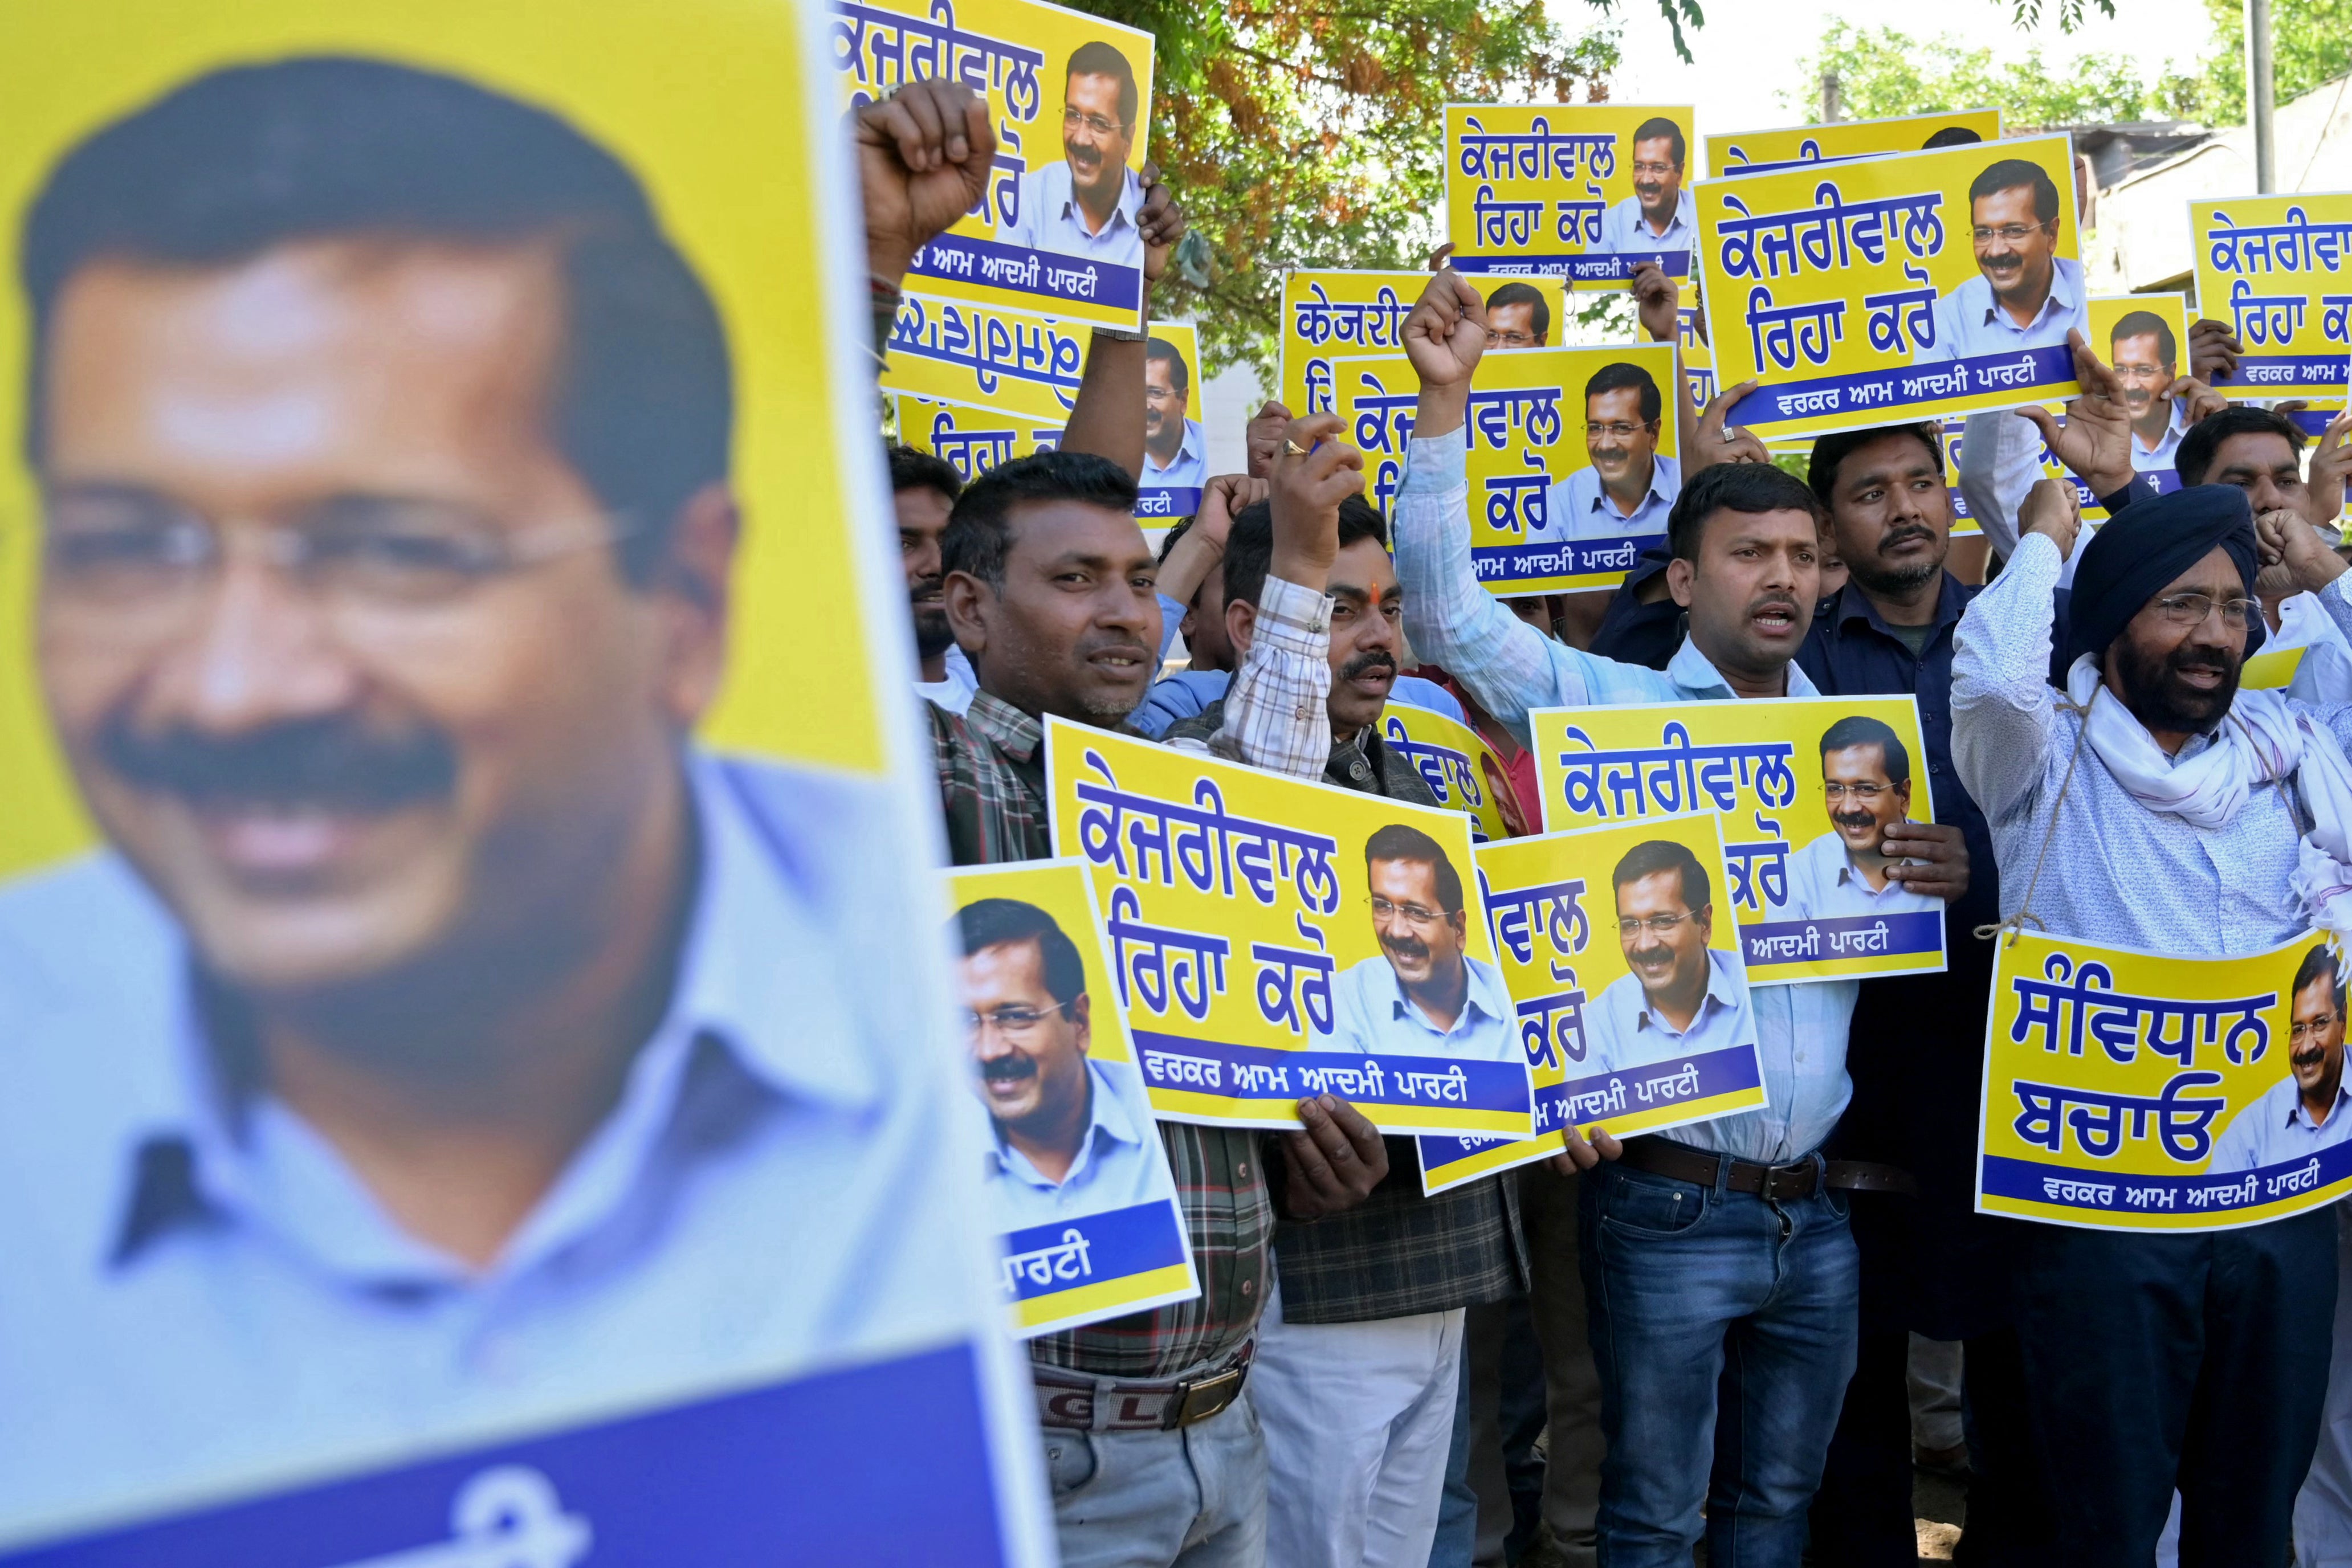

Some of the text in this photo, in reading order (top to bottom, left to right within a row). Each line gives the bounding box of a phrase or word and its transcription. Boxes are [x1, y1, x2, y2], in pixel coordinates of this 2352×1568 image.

[829, 0, 1043, 121] ਕਜਰੀਵਾਲ
[1461, 117, 1616, 179] ਕੇਜਰੀਵਾਲ
[1474, 181, 1606, 246] ਰਿਹਾ ਕਰੋ
[1717, 182, 1943, 279] ਕੇਜਰੀਵਾਲ
[2208, 207, 2352, 273] ਕੇਜਰੀਵਾ
[933, 247, 975, 276] ਆਮ
[981, 255, 1041, 288] ਆਦਮੀ
[1047, 266, 1098, 297] ਪਾਰਟੀ
[1575, 256, 1621, 277] ਆਦਮੀ
[1296, 283, 1415, 346] केजरी
[1746, 287, 1845, 373] ਰਿਹਾ
[1865, 263, 1937, 353] ਕਰੋ
[2230, 280, 2307, 345] ਰਿਹਾ
[1776, 354, 2037, 415] ਵਰਕਰ ਆਮ ਆਦਮੀ ਪਾਰਟੀ
[2245, 365, 2296, 382] ਵਰਕਰ
[2302, 365, 2337, 381] ਆਮ
[1486, 449, 1551, 532] ਕਰੋ
[1514, 546, 1575, 574] ਆਦਮੀ
[1581, 541, 1636, 569] ਪਾਰਟੀ
[1560, 722, 1795, 816] ਕੇਜਰੀਵਾਲ
[1077, 749, 1338, 913] ਕੇਜਰੀਵਾਲ
[1107, 887, 1334, 1035] ਰਿਹਾ ਕਰੋ
[1751, 920, 1889, 959] ਆਦਮੀ ਪਾਰਟੀ
[1517, 957, 1587, 1068] ਕਰੋ
[2011, 954, 2276, 1065] ਸੰਵਿਧਾਨ
[1144, 1050, 1468, 1102] ਵਰਕਰ ਆਮ ਆਦਮੀ ਪਾਰਟੀ
[1555, 1077, 1627, 1120] ਆਦਮੀ
[1635, 1063, 1699, 1103] ਪਾਰਟੀ
[2013, 1072, 2224, 1162] ਬਚਾਓ
[2043, 1157, 2321, 1208] ਵਰਕਰ ਆਮ ਆਦਮੀ ਪਾਰਟੀ
